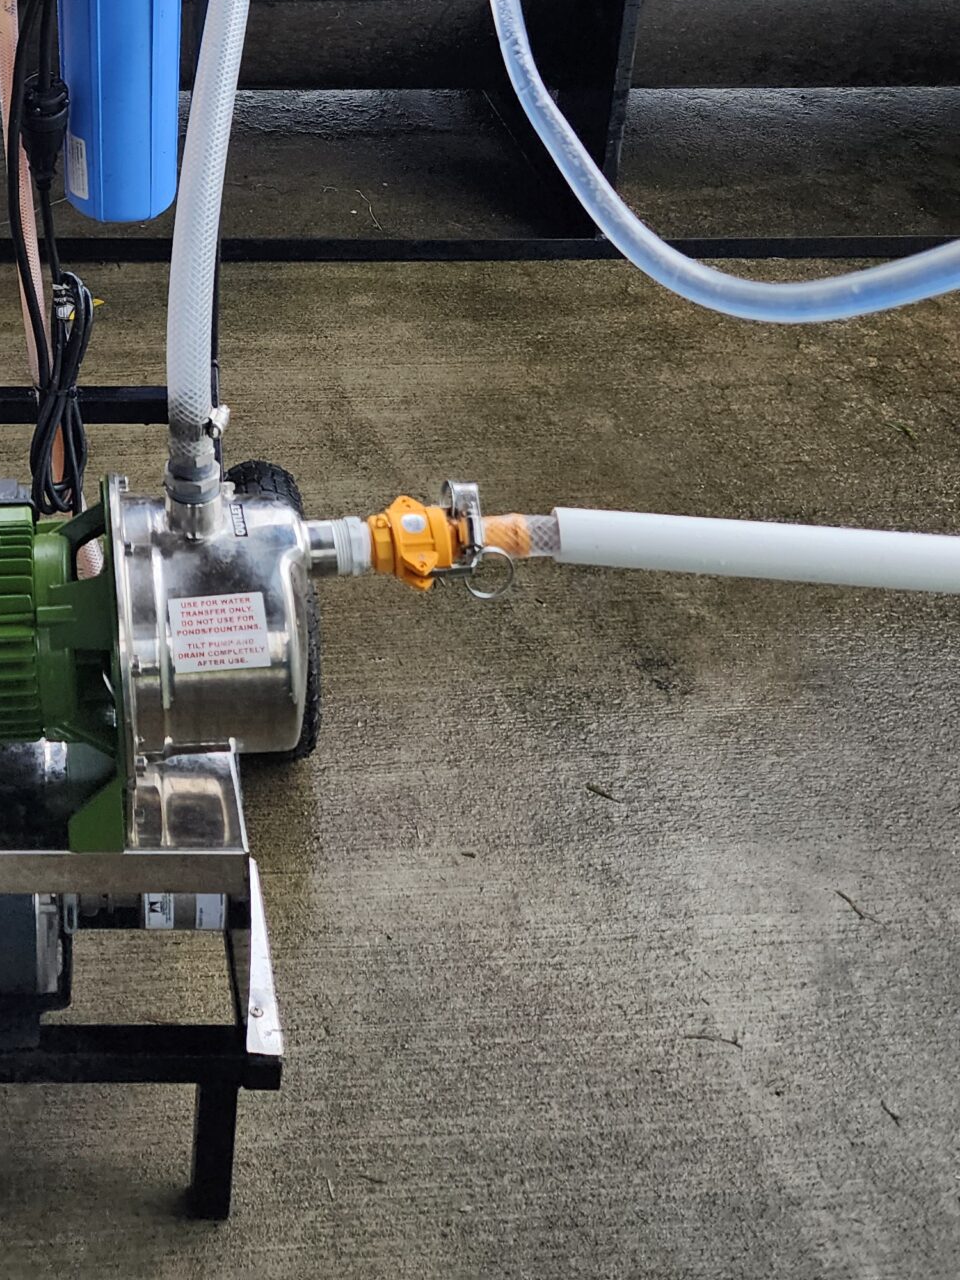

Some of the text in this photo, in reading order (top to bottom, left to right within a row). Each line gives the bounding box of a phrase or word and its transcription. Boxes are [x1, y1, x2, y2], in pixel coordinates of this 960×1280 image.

[231, 504, 246, 536] OUTLET
[180, 601, 198, 609] USE
[221, 597, 251, 605] WATER
[180, 606, 253, 617] TRANSFER ONLY.
[196, 618, 214, 626] NOT
[217, 616, 234, 624] USE
[187, 641, 205, 650] TILT
[178, 646, 265, 660] DRAIN COMPLETELY
[197, 657, 248, 667] AFTER USE.
